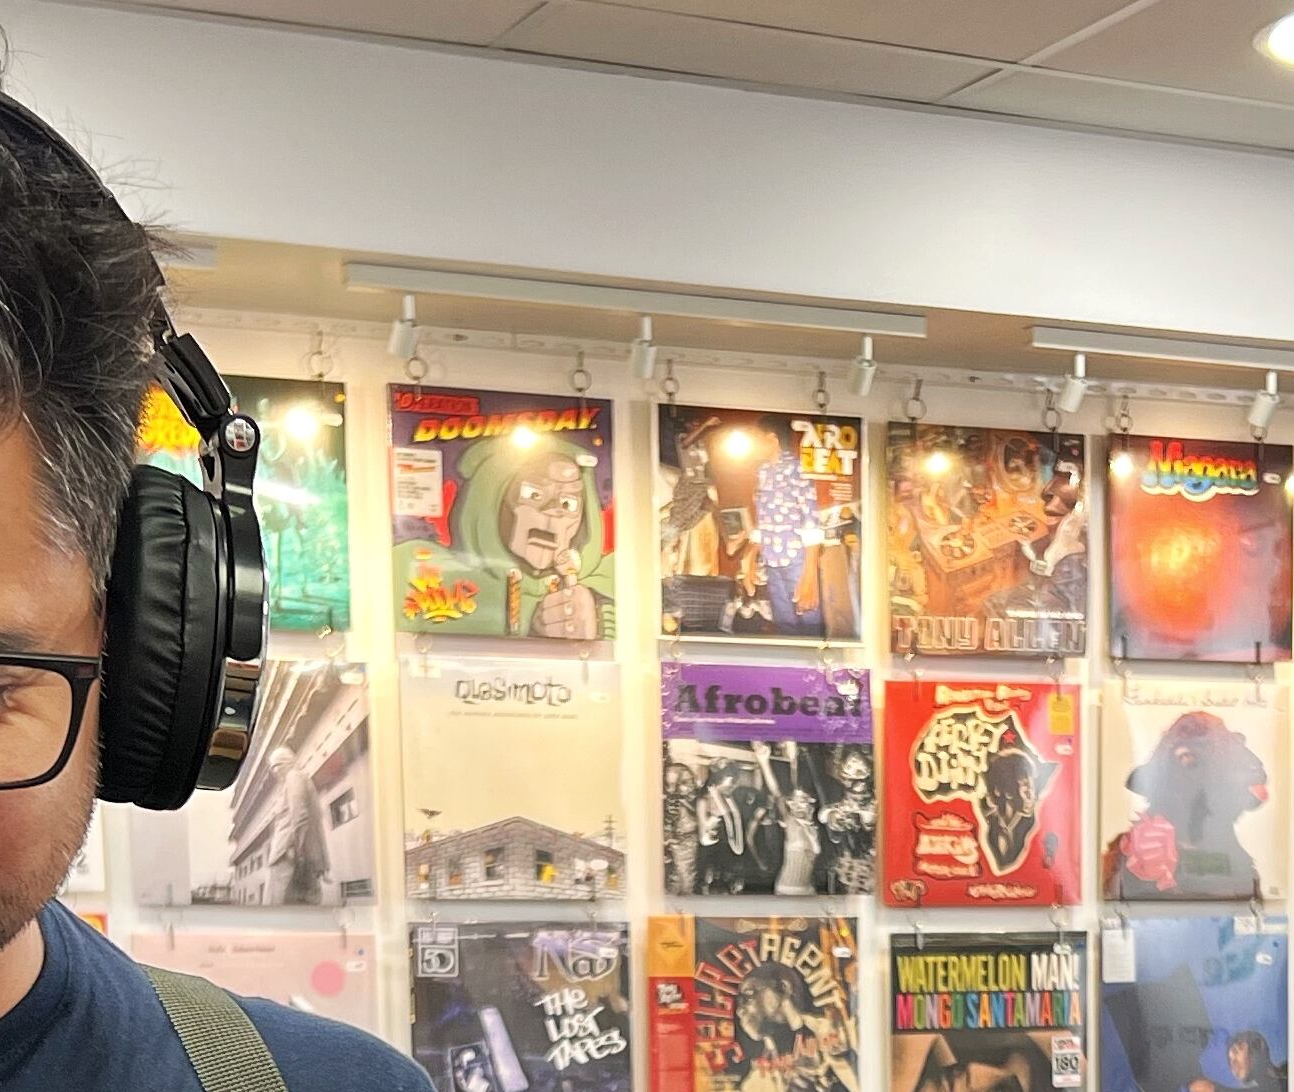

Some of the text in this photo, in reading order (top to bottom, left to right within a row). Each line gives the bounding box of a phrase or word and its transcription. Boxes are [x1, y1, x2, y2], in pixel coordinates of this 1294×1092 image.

[674, 684, 862, 717] Afrobeat
[897, 953, 1027, 993] WATERMELON
[896, 991, 1082, 1030] MONGO SANTAMARIA
